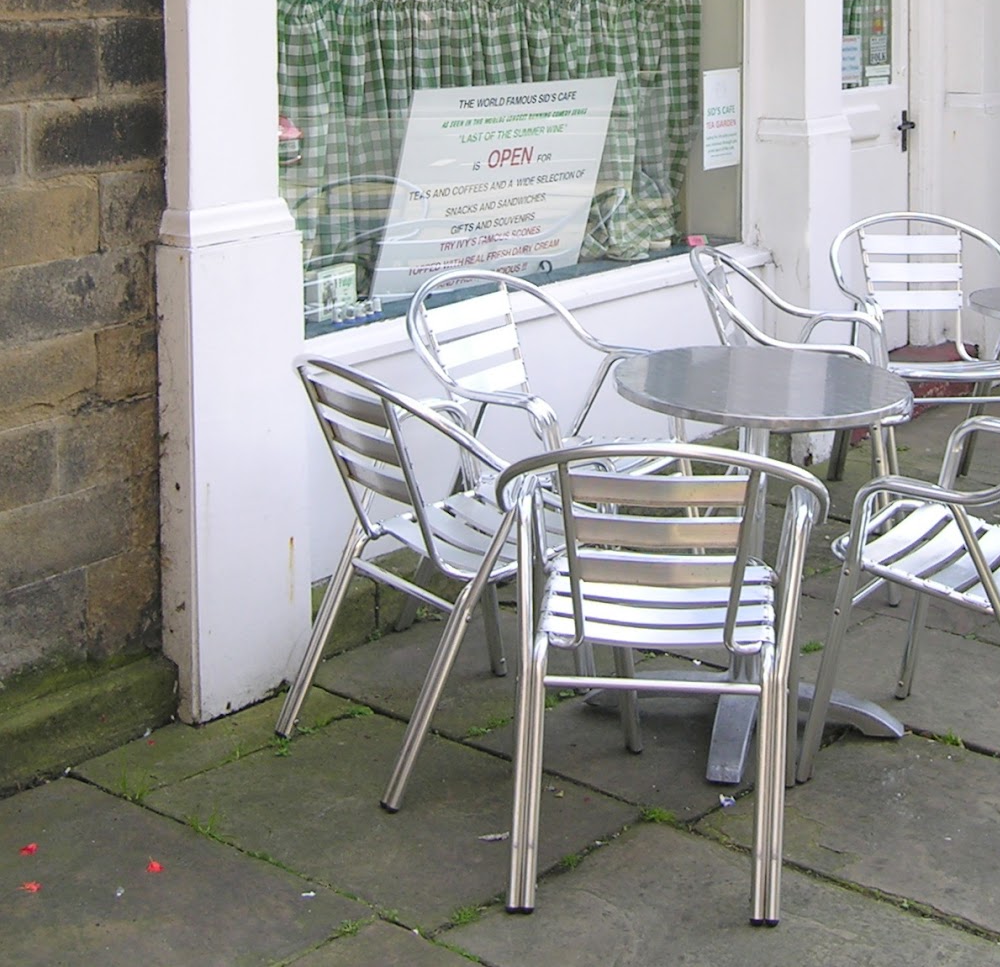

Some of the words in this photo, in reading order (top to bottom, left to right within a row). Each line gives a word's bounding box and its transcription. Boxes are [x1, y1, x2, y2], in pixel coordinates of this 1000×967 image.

[459, 99, 474, 109] THE
[476, 96, 504, 108] WORLD
[506, 94, 537, 106] FAMOUS
[538, 92, 556, 103] SID'S
[558, 91, 577, 102] CAFE
[707, 106, 722, 117] SID'S
[722, 104, 736, 114] CAFE
[484, 132, 496, 140] OF
[498, 130, 512, 140] THE
[513, 126, 546, 138] SUMMER
[706, 122, 714, 130] TEA
[715, 118, 736, 129] GARDEN
[472, 162, 481, 171] IS
[488, 146, 534, 168] OPEN
[537, 153, 552, 162] FOR
[409, 189, 430, 202] TEAS
[432, 187, 450, 198] AND
[452, 183, 488, 196] COFFEES
[490, 180, 507, 190] AND
[508, 178, 513, 188] A
[516, 176, 536, 188] WIDE
[536, 172, 574, 184] SELECTION
[576, 169, 586, 179] OF
[445, 204, 478, 218] SNACKS
[480, 200, 496, 212] AND
[450, 222, 474, 235] GIFTS
[475, 220, 492, 232] AND
[494, 212, 536, 228] SOUVENIRS
[440, 240, 456, 252] TRY
[456, 236, 476, 250] IVY'S
[478, 232, 510, 246] FAMOUS
[511, 226, 542, 237] SCONES
[464, 252, 485, 266] REAL
[486, 247, 512, 262] FRESH
[512, 244, 534, 258] DAIRY
[534, 238, 560, 251] CREAM
